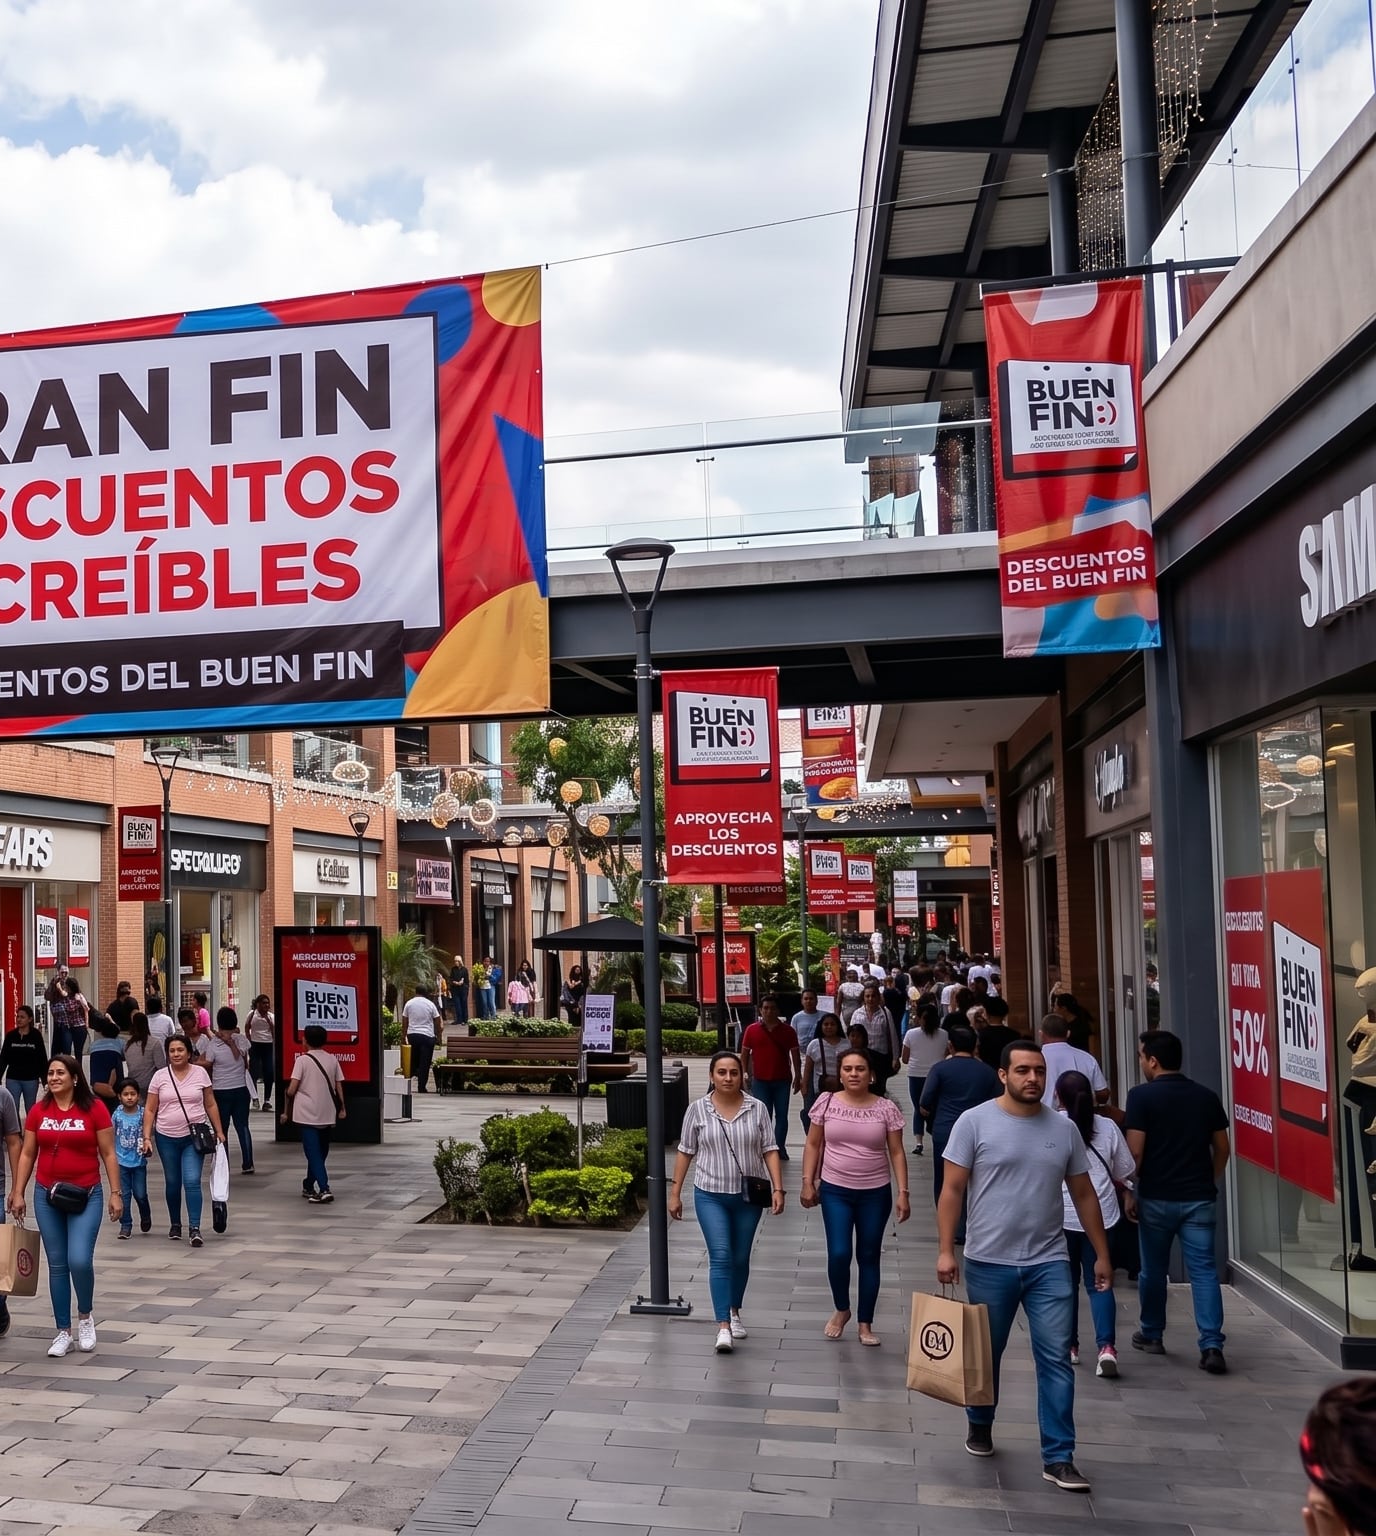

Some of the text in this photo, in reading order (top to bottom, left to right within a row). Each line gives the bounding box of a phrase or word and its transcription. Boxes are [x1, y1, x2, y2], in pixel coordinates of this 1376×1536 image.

[210, 343, 391, 446] FIN
[1027, 379, 1115, 402] BUEN
[1007, 546, 1146, 575] DESCUENTOS
[1008, 566, 1146, 593] DEL BUEN FIN
[121, 660, 190, 692] DEL
[200, 654, 300, 687] BUEN
[314, 649, 375, 681] FIN
[689, 706, 755, 726] BUEN
[674, 811, 773, 825] APROVECHA
[709, 828, 739, 840] LOS
[671, 843, 777, 857] DESCUENTOS
[1280, 956, 1317, 1006] BUEN
[305, 991, 349, 1006] BUEN
[1232, 1008, 1269, 1077] 50%
